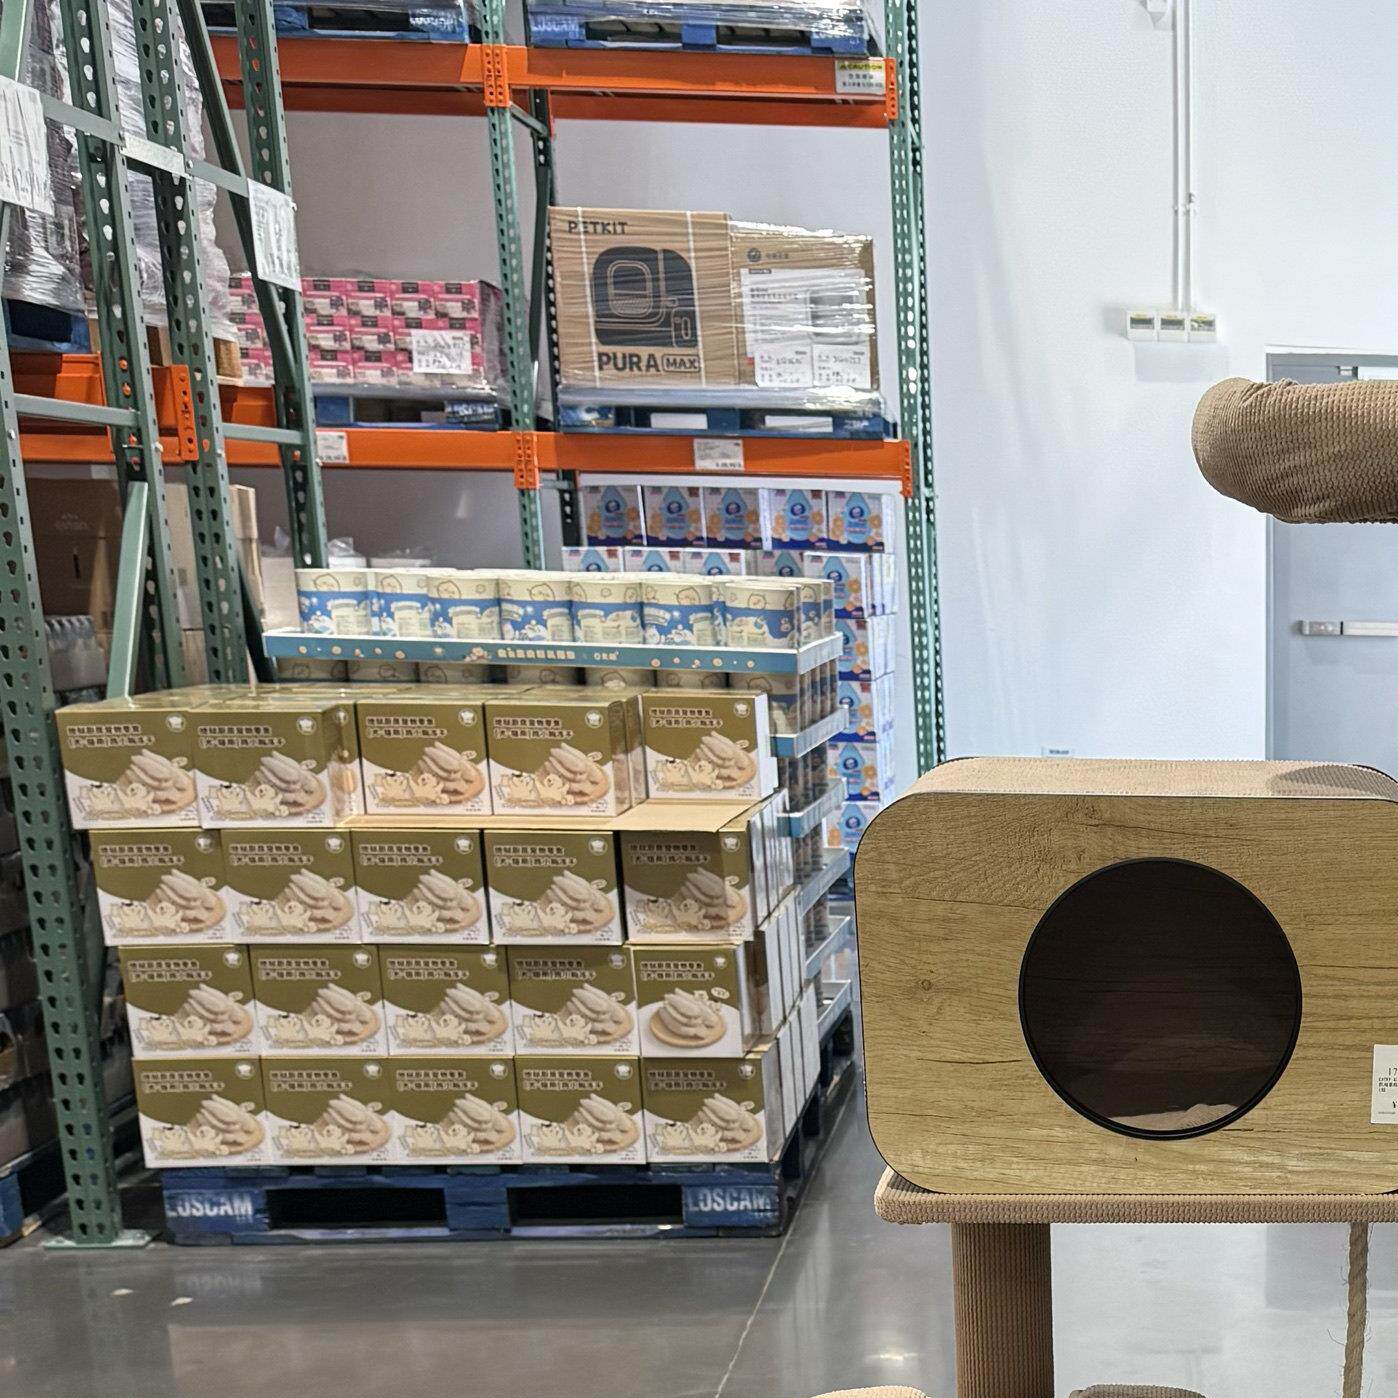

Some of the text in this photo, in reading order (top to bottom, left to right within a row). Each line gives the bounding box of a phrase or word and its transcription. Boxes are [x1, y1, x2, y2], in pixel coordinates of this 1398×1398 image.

[567, 220, 628, 235] PETKIT
[599, 352, 699, 373] PURA MAX
